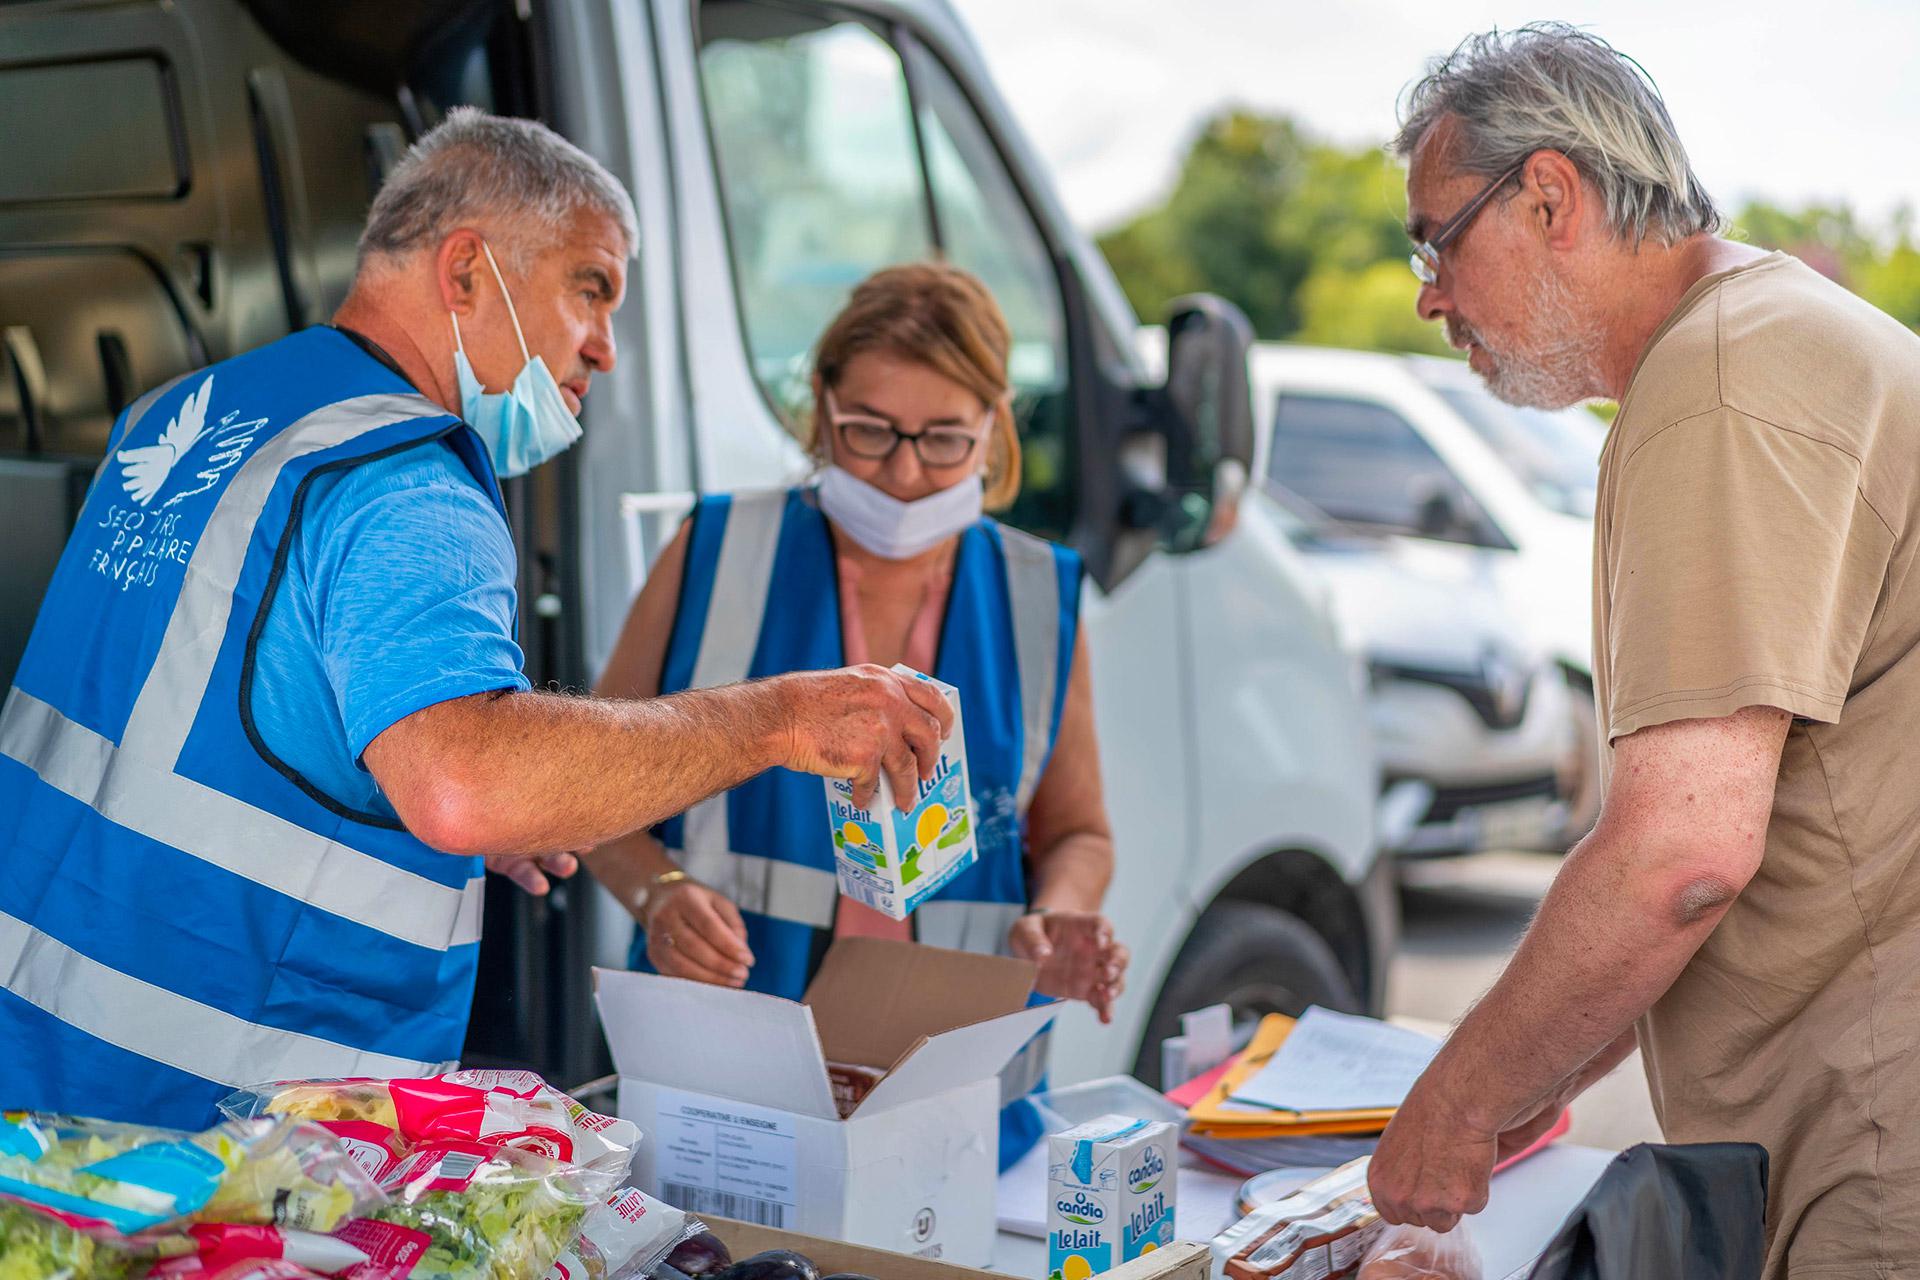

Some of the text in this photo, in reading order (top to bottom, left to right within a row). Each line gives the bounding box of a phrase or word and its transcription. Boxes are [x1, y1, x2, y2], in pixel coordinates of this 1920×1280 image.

[1128, 1154, 1163, 1185] candia
[615, 1191, 644, 1219] LAITUE
[1057, 1200, 1103, 1218] candia
